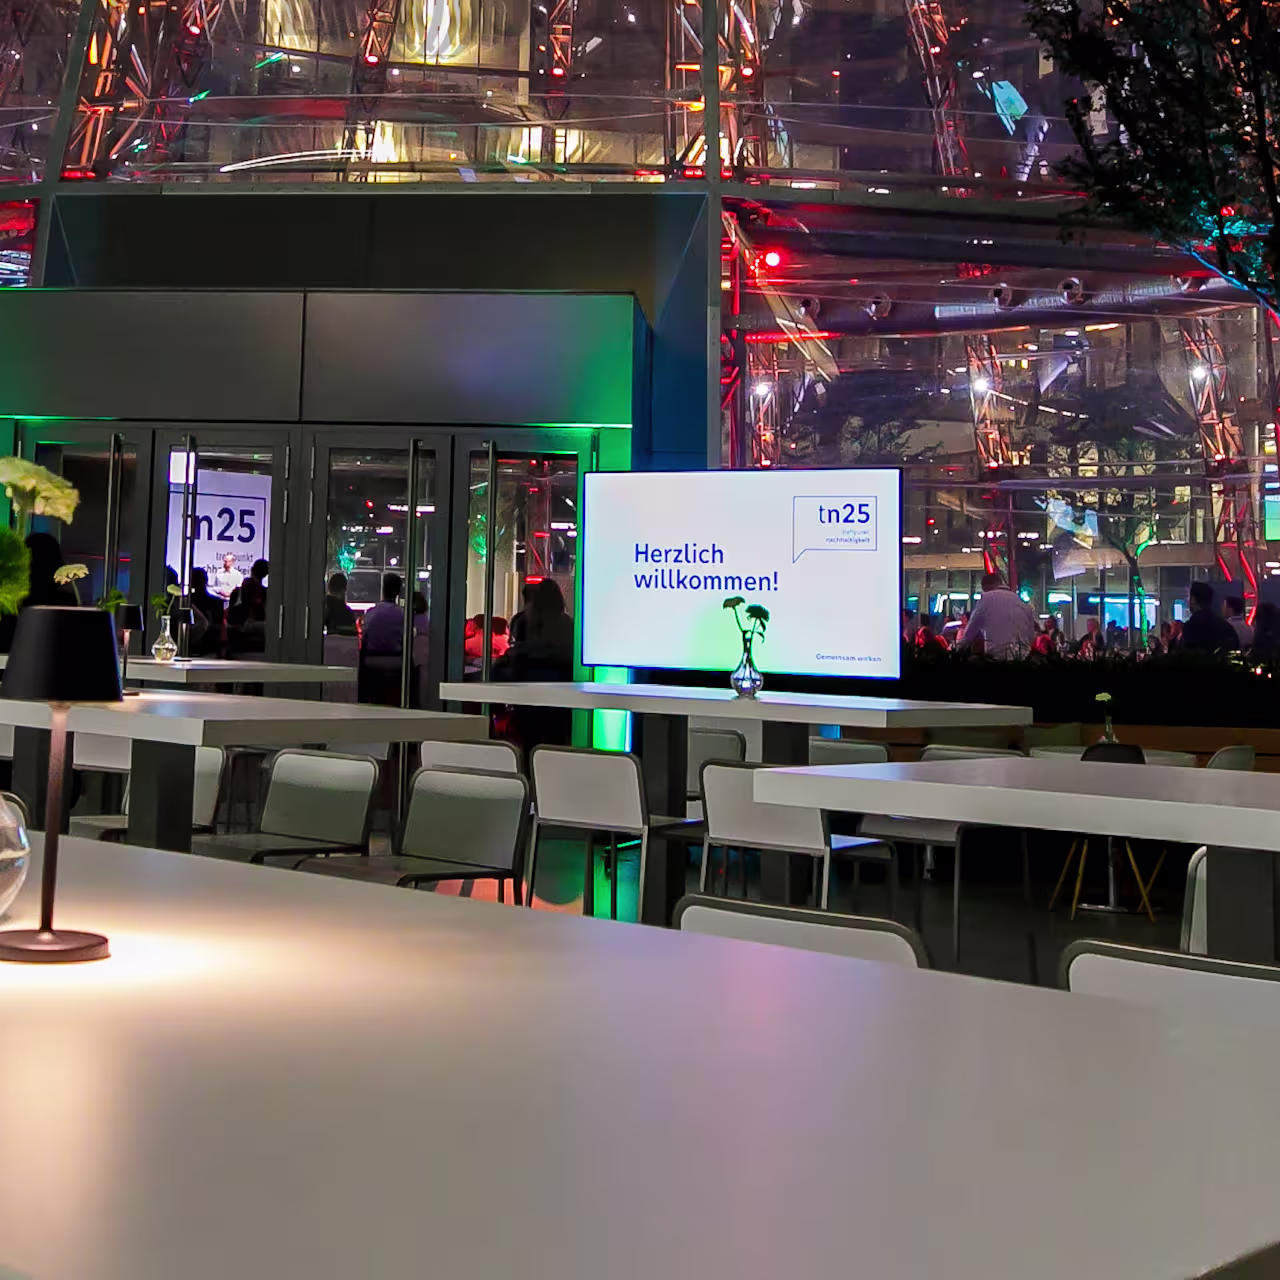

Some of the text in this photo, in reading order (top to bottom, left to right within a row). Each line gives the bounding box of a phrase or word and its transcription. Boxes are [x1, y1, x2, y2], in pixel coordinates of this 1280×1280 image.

[818, 503, 870, 524] tn25
[634, 543, 724, 564] Herzlich
[633, 569, 779, 591] willkommen!
